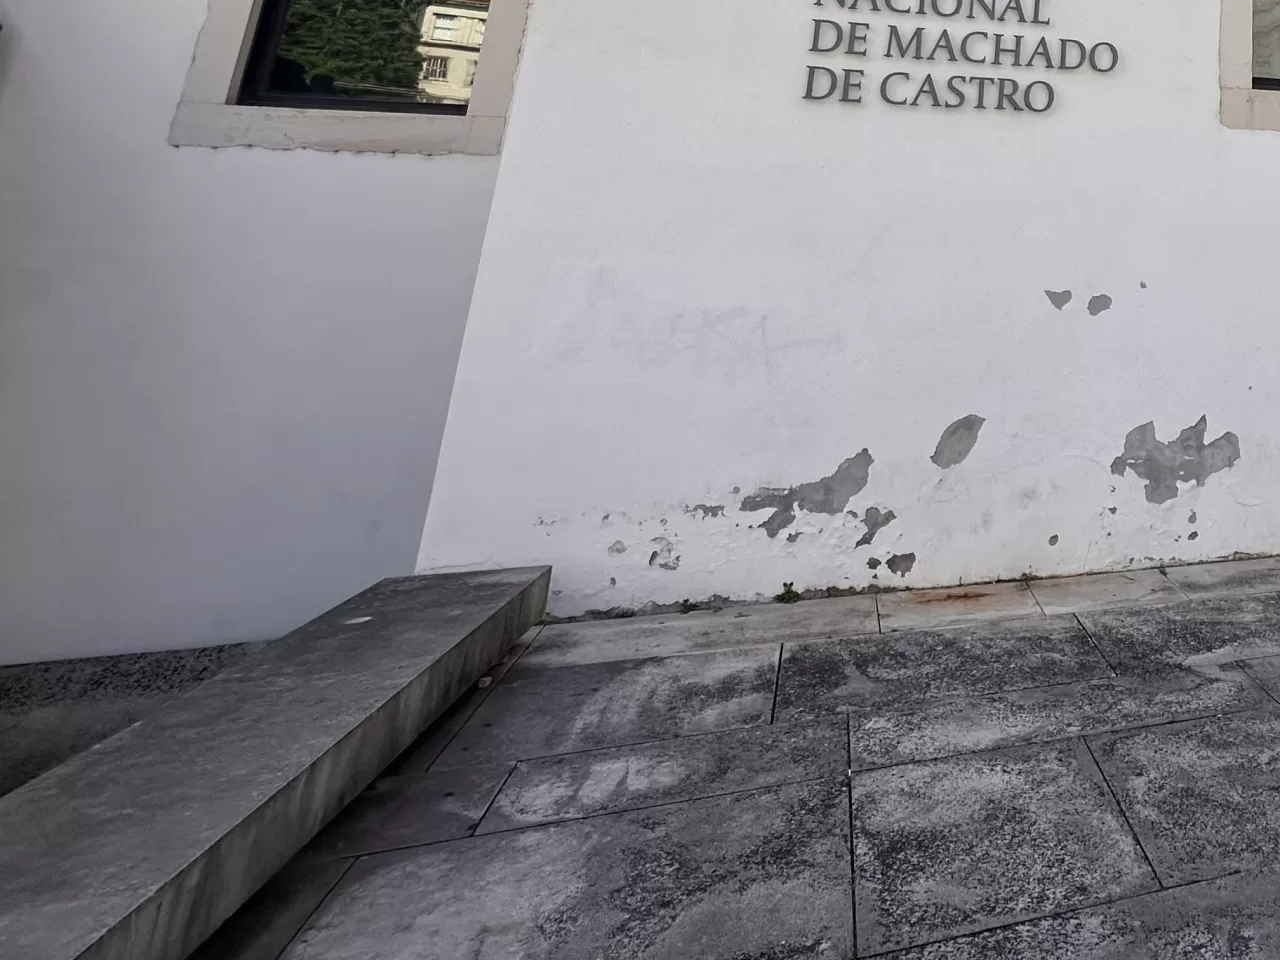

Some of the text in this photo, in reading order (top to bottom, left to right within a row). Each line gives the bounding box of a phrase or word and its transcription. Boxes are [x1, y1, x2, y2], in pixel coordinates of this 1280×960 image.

[808, 18, 1119, 72] DE MACHADO
[802, 65, 1055, 113] DE CASTRO
